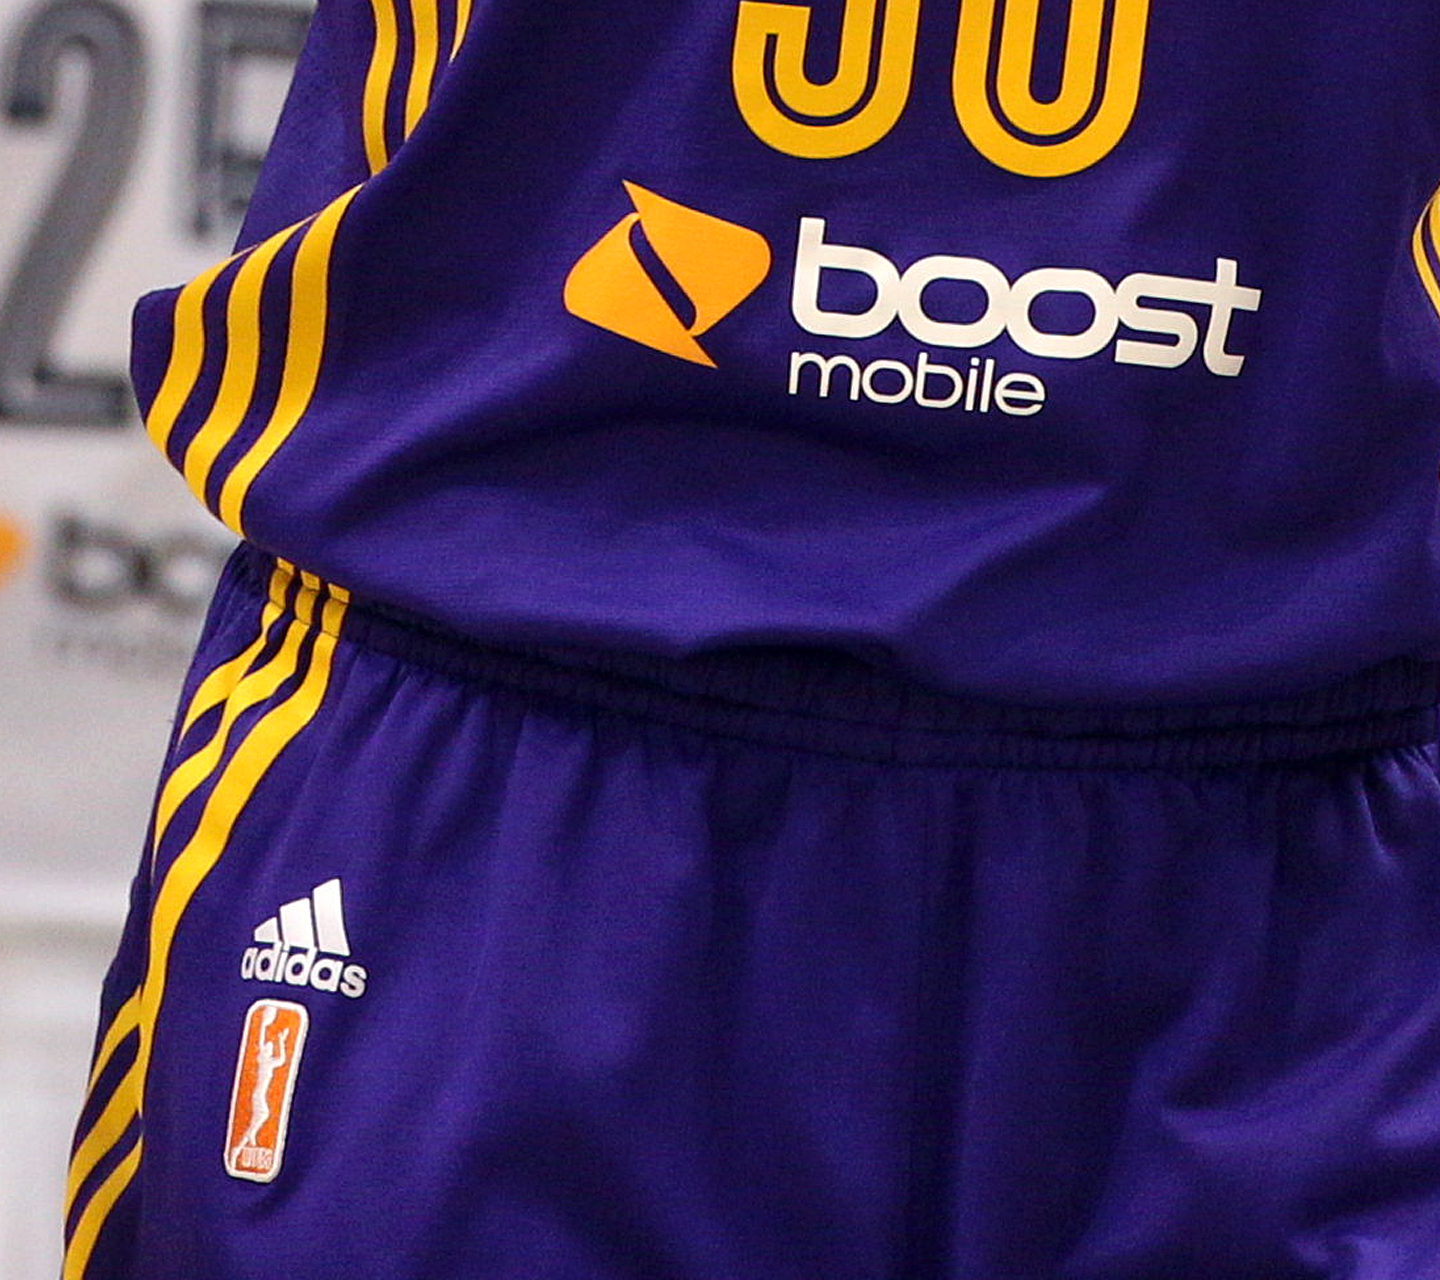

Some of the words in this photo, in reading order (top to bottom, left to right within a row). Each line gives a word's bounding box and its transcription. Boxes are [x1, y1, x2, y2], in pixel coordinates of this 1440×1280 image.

[791, 216, 1262, 376] boost
[787, 351, 1046, 416] mobile
[240, 940, 368, 998] adidas
